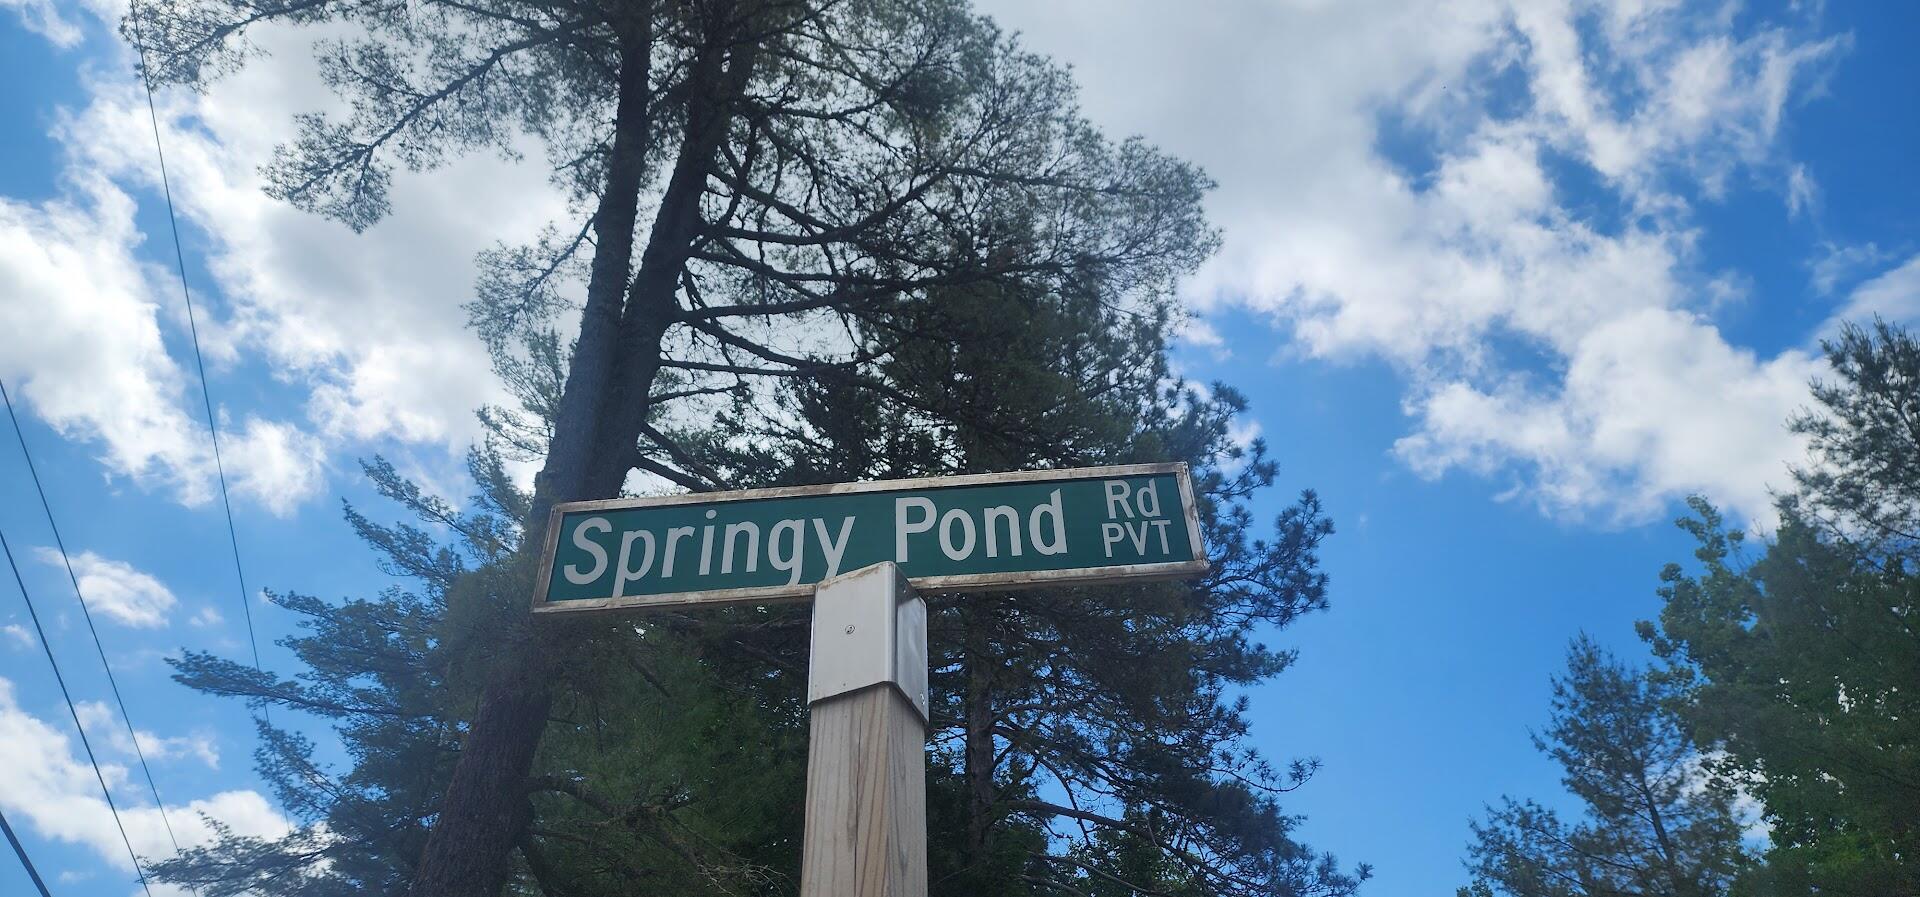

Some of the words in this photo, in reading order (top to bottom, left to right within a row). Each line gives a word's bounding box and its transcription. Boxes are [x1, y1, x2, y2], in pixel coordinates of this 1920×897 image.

[1105, 479, 1160, 518] Rd
[563, 509, 856, 599] Springy
[895, 488, 1068, 563] Pond
[1101, 519, 1171, 558] PVT
